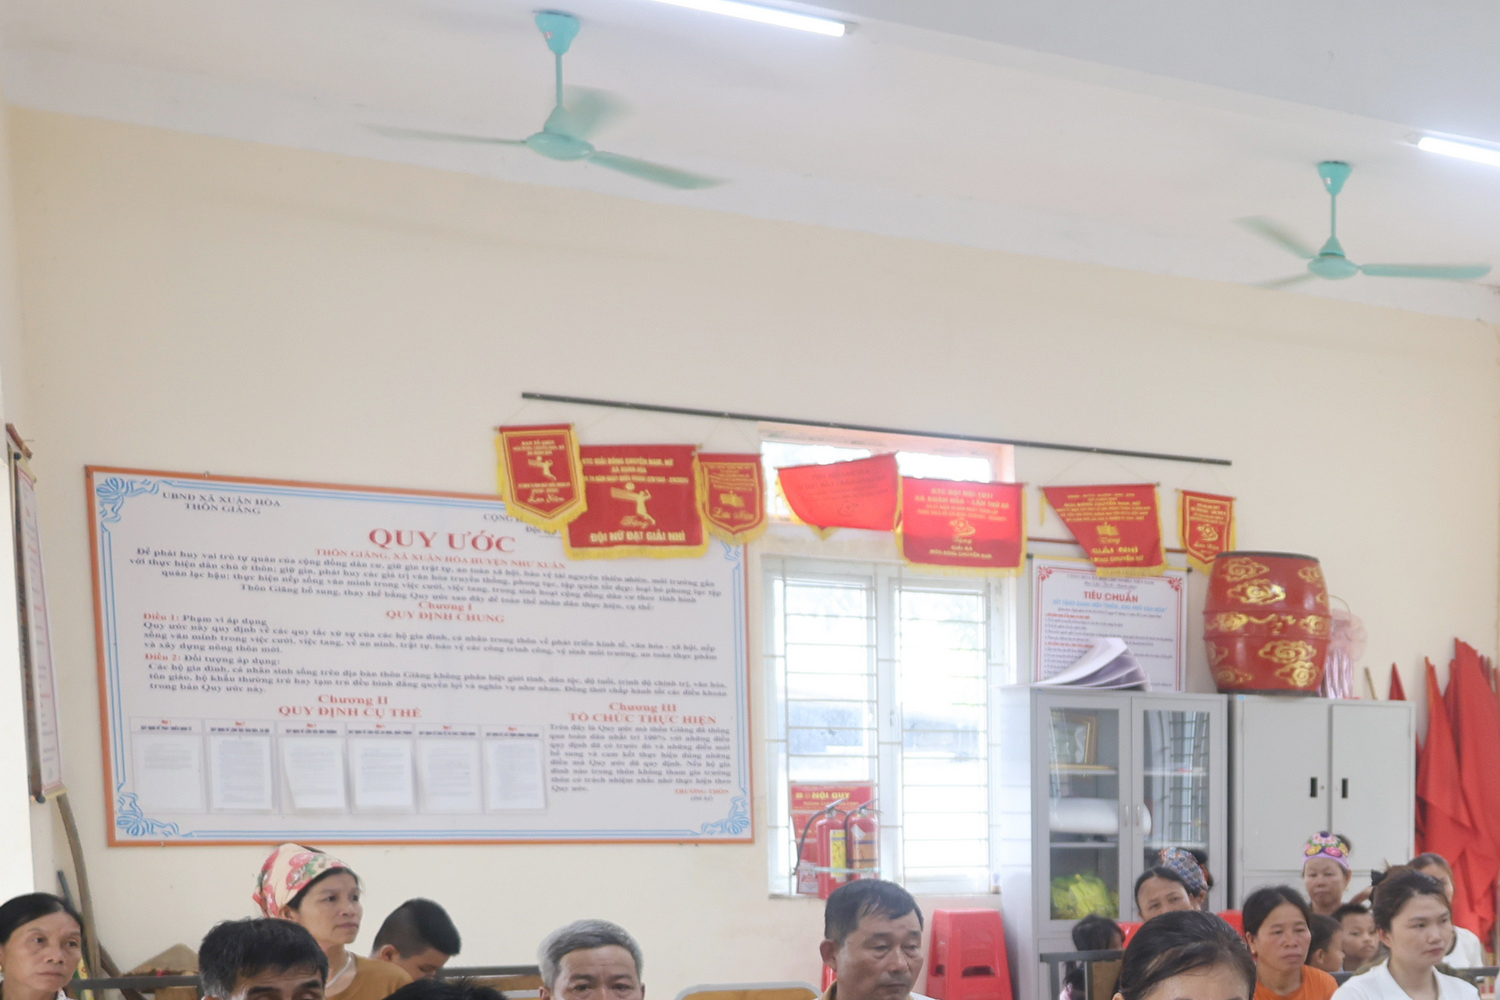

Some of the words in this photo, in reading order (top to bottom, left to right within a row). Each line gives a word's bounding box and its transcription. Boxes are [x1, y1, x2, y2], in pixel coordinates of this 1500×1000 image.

[162, 491, 195, 500] UBND
[199, 492, 215, 502] XÃ
[219, 494, 251, 504] XUÂN
[255, 496, 281, 506] HÒA
[185, 501, 218, 511] THÔN
[222, 503, 261, 514] GIĂNG
[368, 527, 437, 549] QUY
[447, 529, 515, 552] ƯỚC
[590, 530, 607, 544] ĐỘI
[609, 529, 625, 541] NỮ
[626, 530, 643, 543] ĐẠT
[646, 528, 666, 542] GIẢI
[136, 546, 150, 555] Để
[153, 548, 176, 557] phát
[179, 550, 197, 559] huy
[201, 551, 217, 559] vai
[237, 554, 248, 562] tự
[298, 557, 320, 566] cộng
[323, 557, 347, 568] đồng
[349, 560, 367, 568] dân
[148, 558, 170, 566] thực
[174, 559, 195, 568] hiện
[198, 560, 217, 568] dân
[315, 547, 347, 556] THÔN
[393, 551, 410, 560] XÃ
[412, 552, 441, 561] XUÂN
[445, 554, 468, 563] HÒA
[536, 559, 565, 568] XUÂN
[189, 570, 203, 578] lạc
[232, 573, 254, 581] thực
[258, 574, 278, 582] hiện
[242, 583, 265, 591] Thôn
[1083, 590, 1102, 600] TIÊU
[1105, 590, 1138, 602] CHUẨN
[418, 600, 464, 611] Chương
[143, 611, 167, 620] Điều
[182, 614, 211, 623] Phạm
[226, 615, 239, 624] áp
[241, 616, 267, 625] dụng
[386, 609, 413, 618] QUY
[419, 611, 452, 621] ĐỊNH
[456, 613, 504, 622] CHUNG
[143, 621, 164, 630] Quy
[190, 624, 207, 632] này
[233, 625, 255, 633] định
[159, 642, 175, 650] xây
[179, 642, 205, 651] dựng
[208, 644, 232, 652] nông
[236, 644, 258, 652] thôn
[145, 652, 168, 660] Điều
[183, 653, 201, 661] Đối
[205, 656, 234, 664] tượng
[237, 656, 249, 664] áp
[171, 663, 183, 671] hộ
[186, 664, 200, 672] gia
[295, 667, 317, 676] sống
[150, 683, 176, 691] trong
[201, 683, 221, 692] Quy
[318, 694, 373, 706] Chương
[377, 695, 388, 704] II
[278, 705, 313, 716] QUY
[318, 706, 358, 718] ĐỊNH
[363, 707, 384, 718] CỤ
[390, 706, 421, 717] THỂ
[608, 702, 658, 712] Chương
[661, 703, 677, 712] III
[570, 711, 589, 722] TỔ
[592, 711, 635, 723] CHỨC
[639, 713, 678, 724] THỰC
[682, 714, 716, 725] HIỆN
[831, 791, 850, 799] QUY
